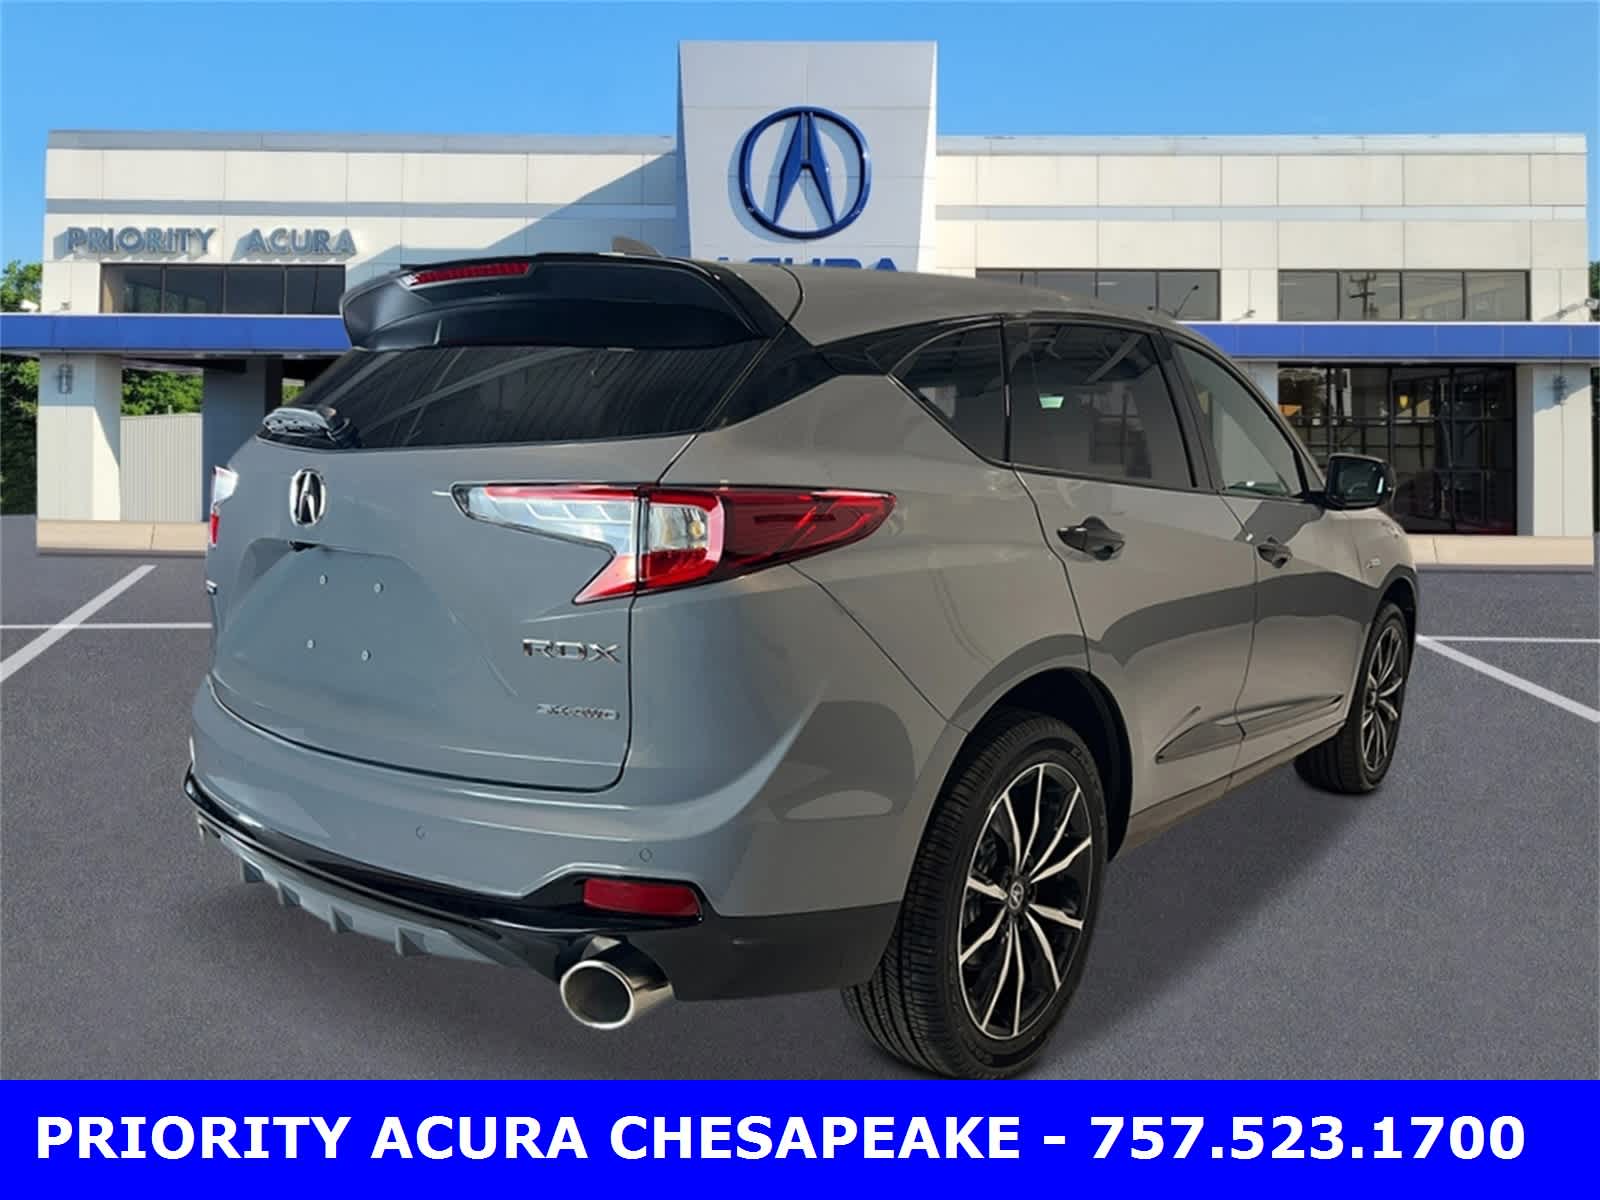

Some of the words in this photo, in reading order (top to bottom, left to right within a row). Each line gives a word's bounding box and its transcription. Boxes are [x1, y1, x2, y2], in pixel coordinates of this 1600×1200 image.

[67, 227, 216, 252] PRIORITY
[249, 228, 356, 255] ACURA
[523, 639, 621, 663] RDX
